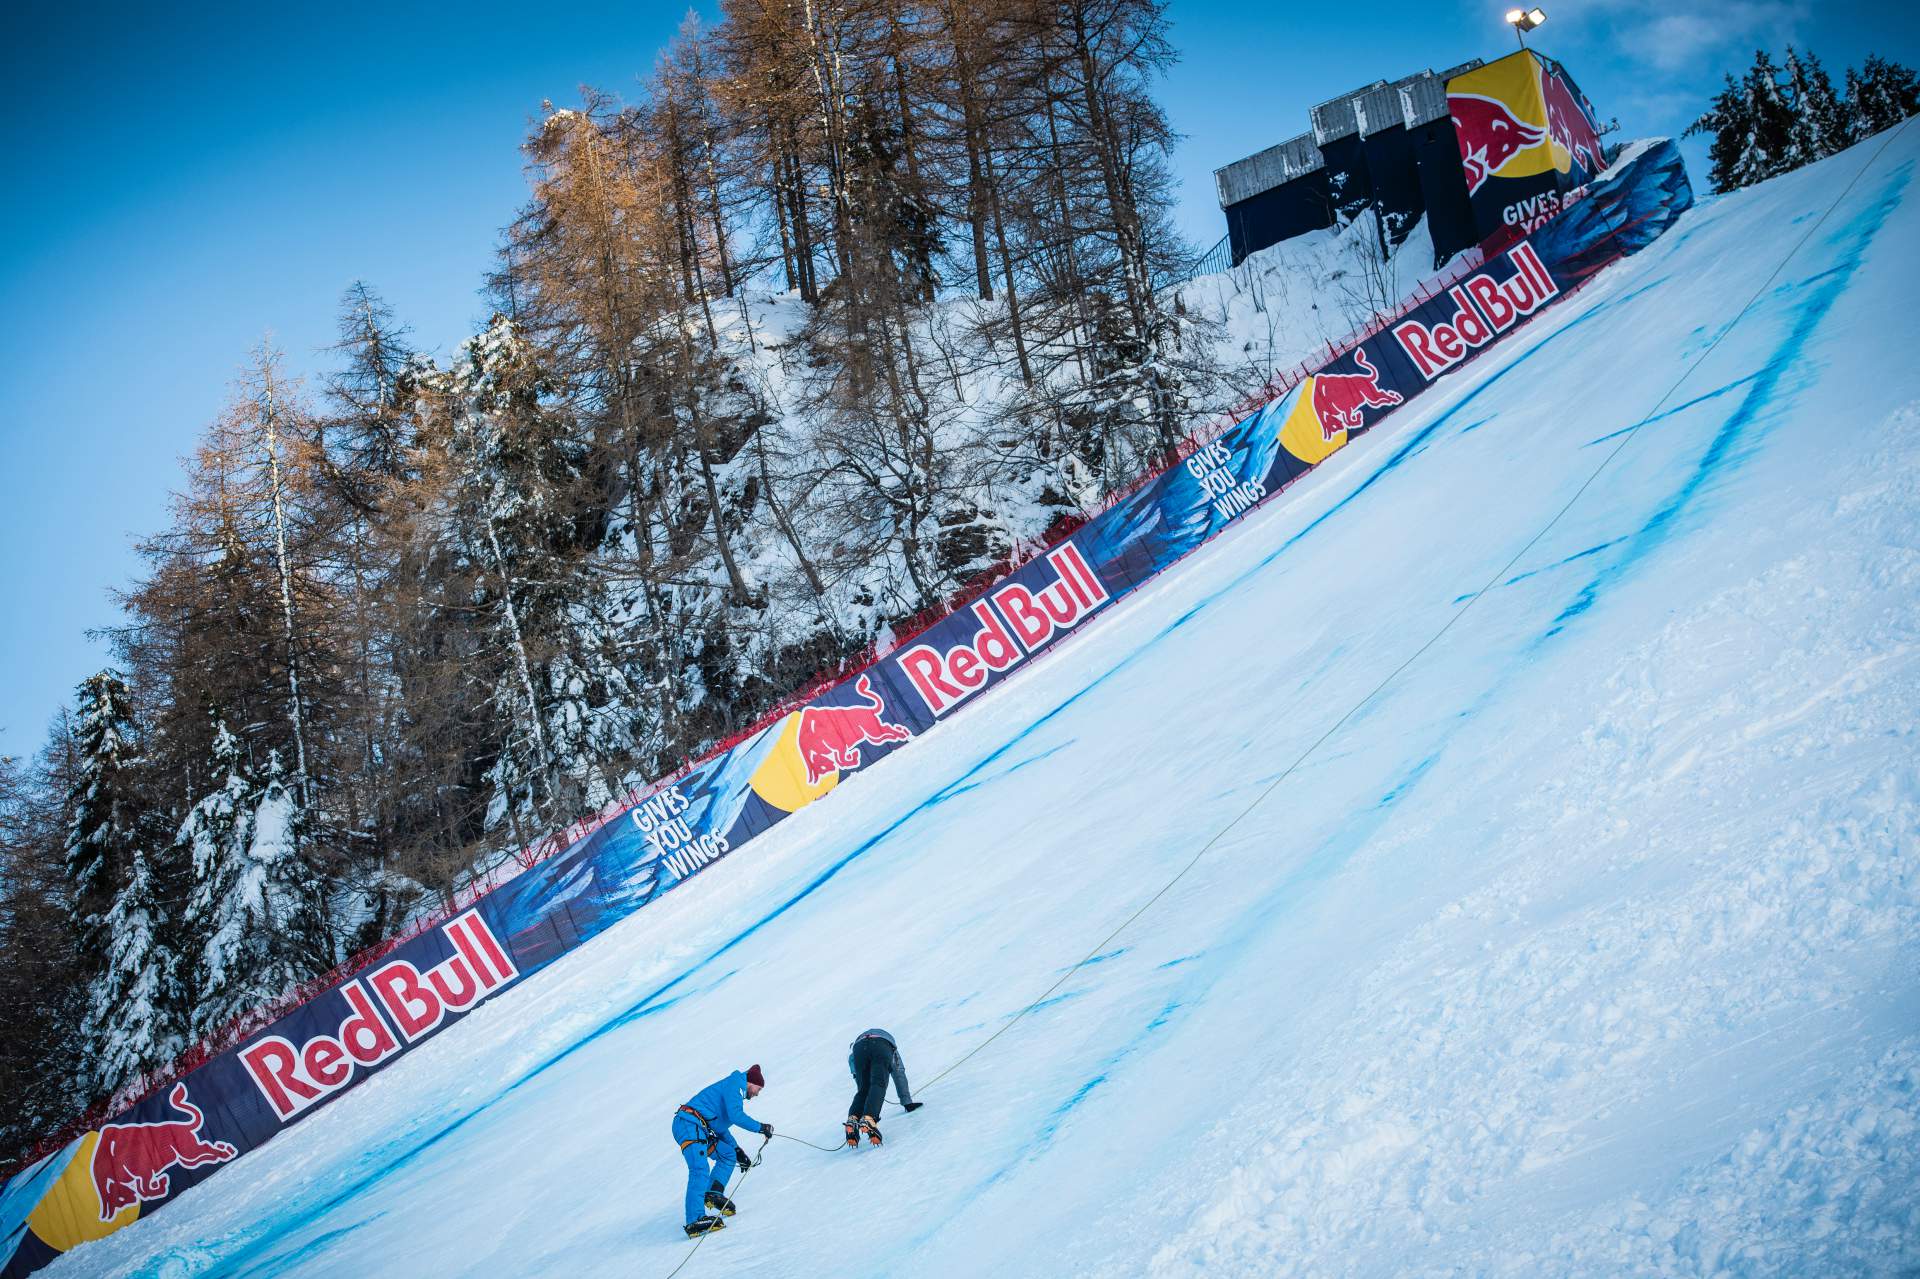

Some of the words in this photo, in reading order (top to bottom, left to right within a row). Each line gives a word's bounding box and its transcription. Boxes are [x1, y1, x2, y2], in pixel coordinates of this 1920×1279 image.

[1503, 189, 1560, 226] GIVES
[1393, 286, 1494, 381] Red
[1459, 241, 1560, 331] Bull
[1187, 440, 1232, 480] GIVES
[1199, 467, 1237, 500] YOU
[1213, 476, 1267, 520] WINGS
[897, 599, 1024, 716] Red
[992, 540, 1109, 652] Bull
[631, 785, 690, 833] GIVES
[646, 818, 693, 855] YOU
[662, 827, 730, 881] WINGS
[238, 980, 401, 1122] Red
[367, 908, 519, 1043] Bull
